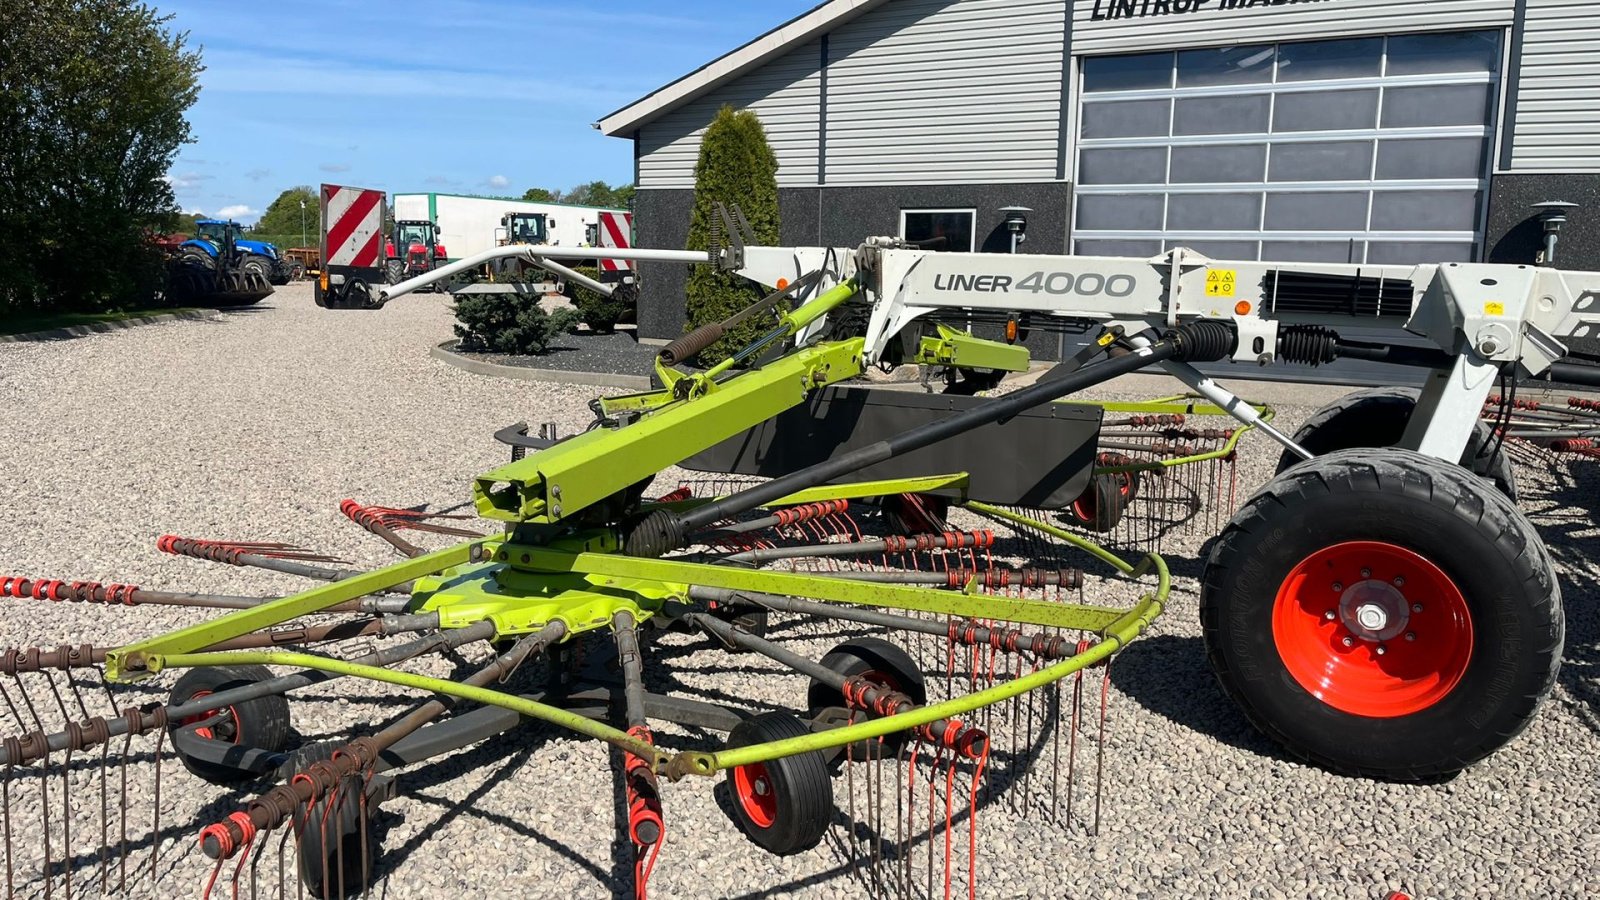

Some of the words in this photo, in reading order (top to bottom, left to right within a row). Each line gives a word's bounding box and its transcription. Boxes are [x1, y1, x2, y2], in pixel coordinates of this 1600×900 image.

[1090, 0, 1210, 22] LINTRUP
[933, 274, 1013, 293] LINER
[1015, 271, 1137, 297] 4000
